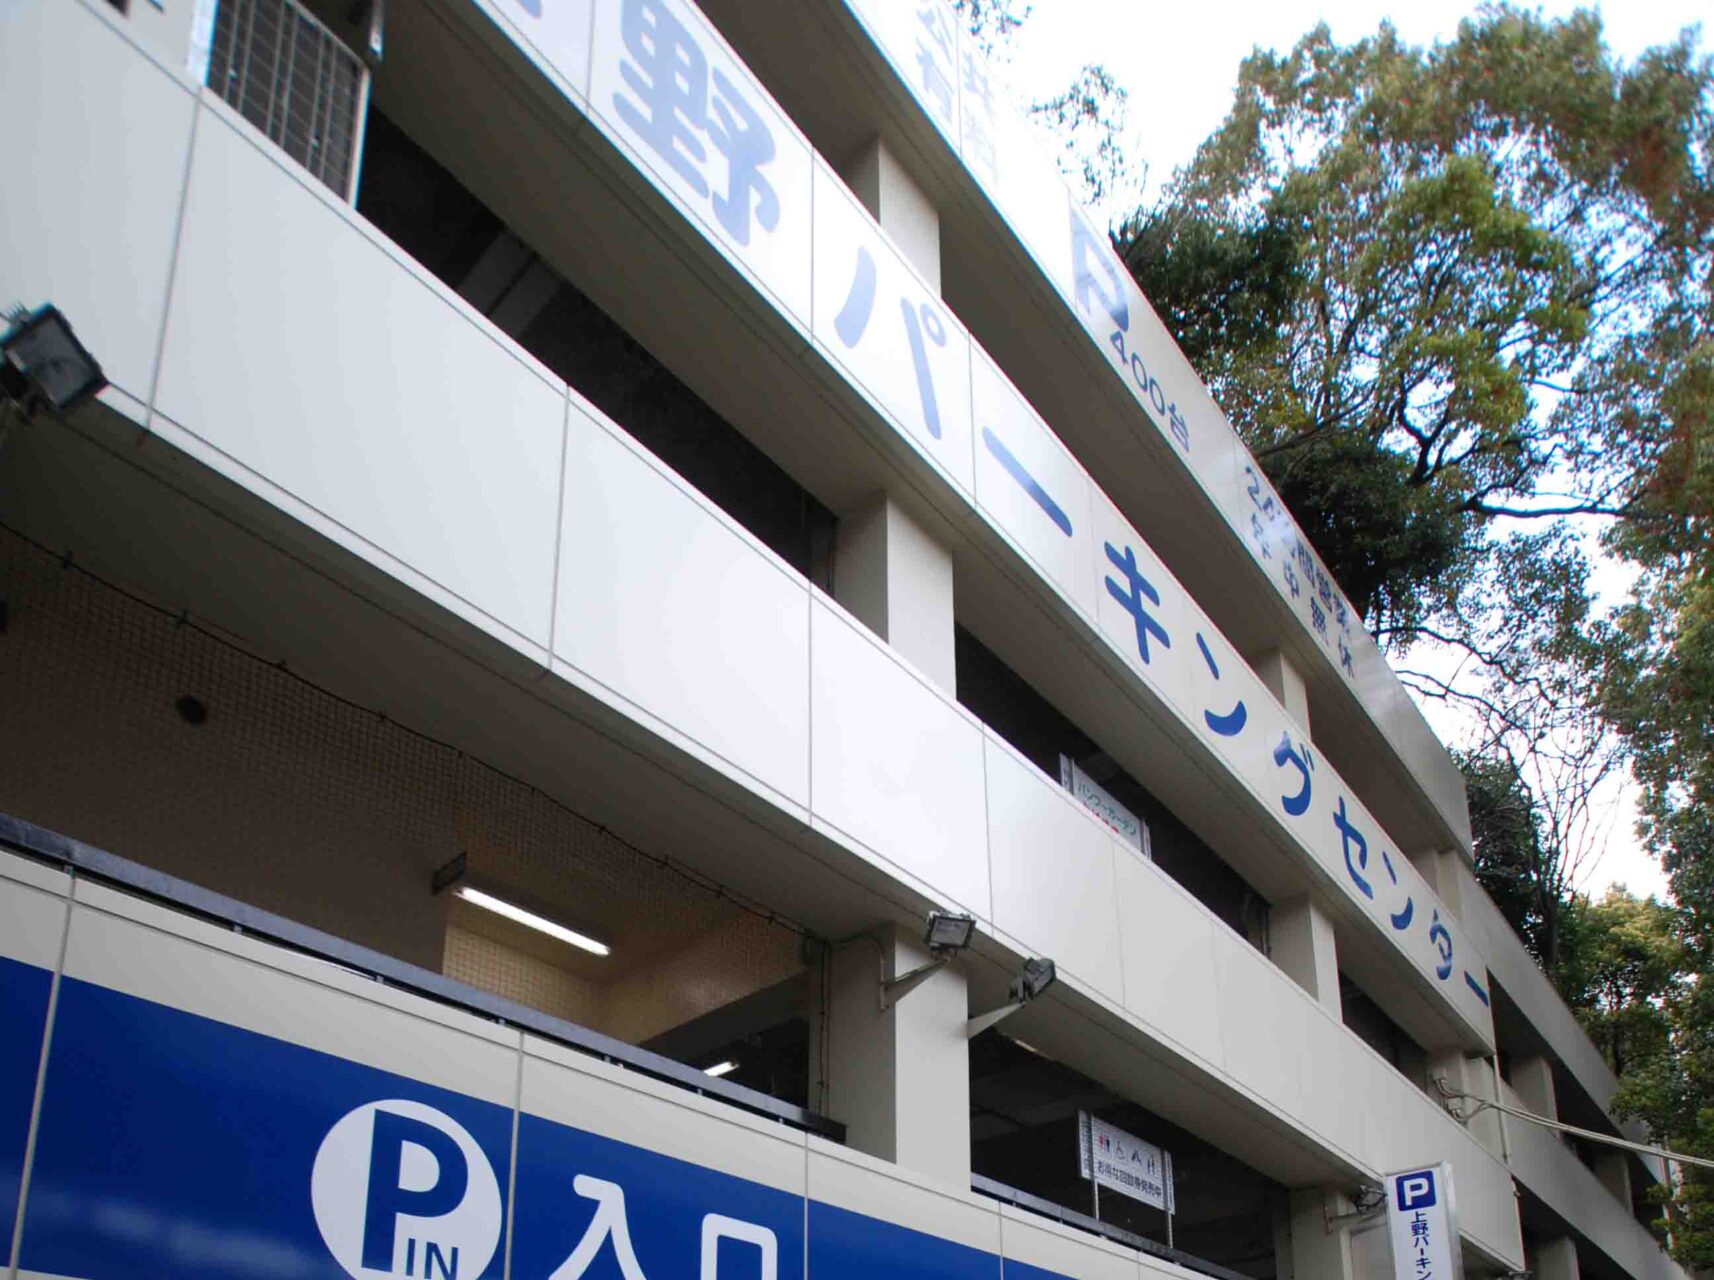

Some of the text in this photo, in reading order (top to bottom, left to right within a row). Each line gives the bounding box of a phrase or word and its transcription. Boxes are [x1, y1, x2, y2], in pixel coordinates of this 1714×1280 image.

[1110, 331, 1190, 453] 400台
[518, 0, 1489, 1008] 野パーキングセンター
[1403, 1177, 1430, 1206] P
